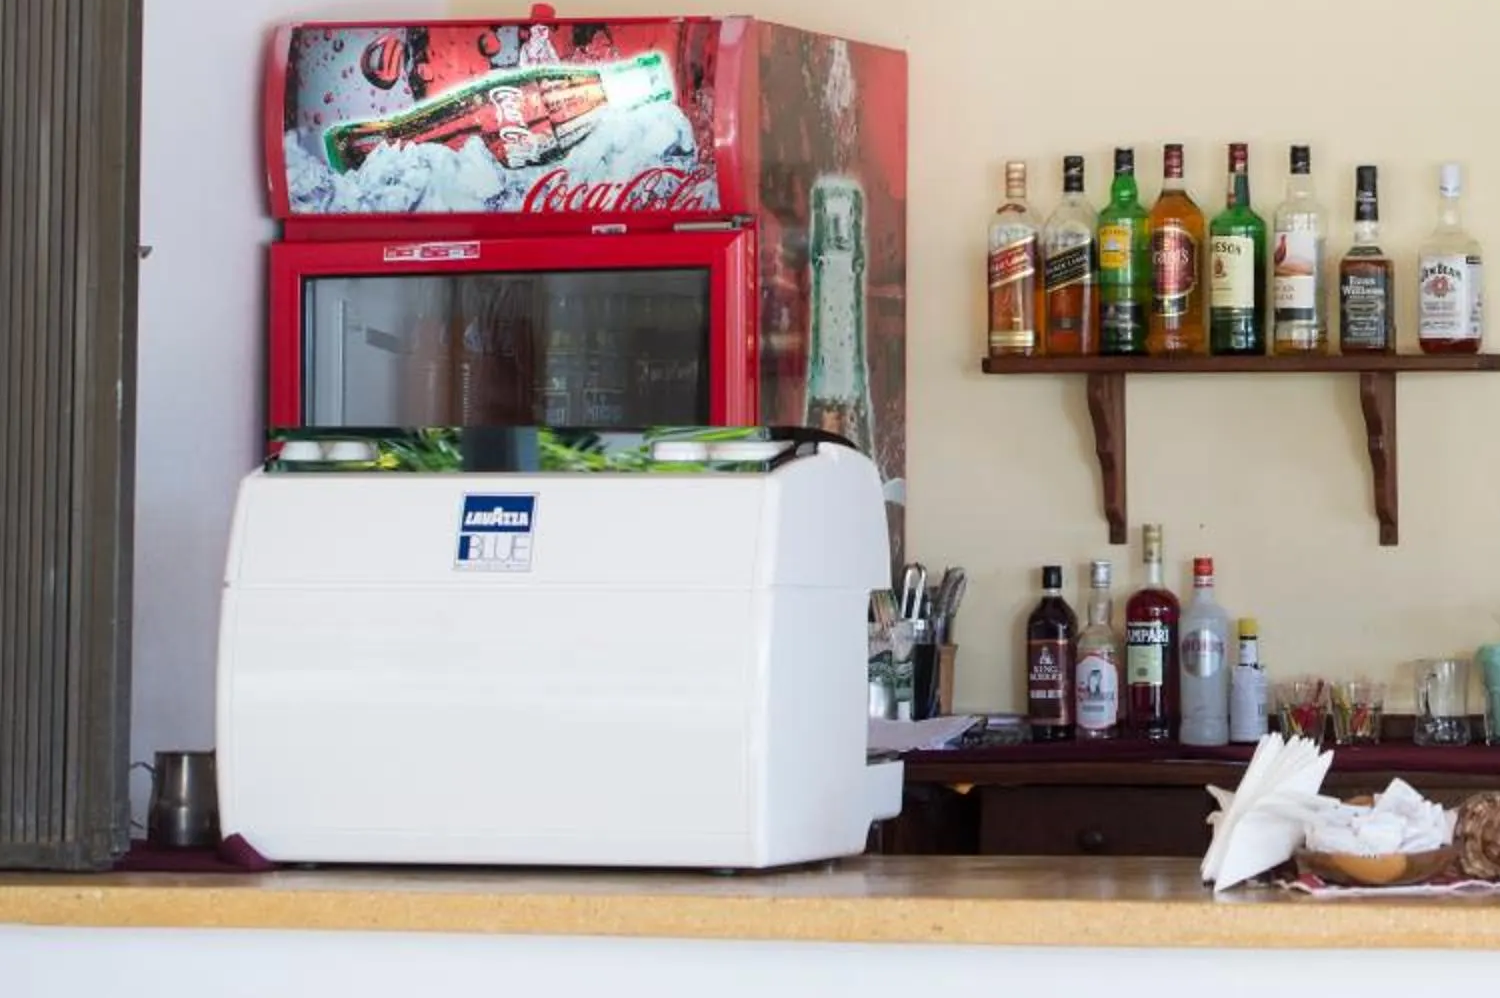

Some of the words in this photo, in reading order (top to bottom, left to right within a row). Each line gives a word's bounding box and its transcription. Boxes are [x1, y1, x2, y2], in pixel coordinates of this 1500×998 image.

[523, 168, 712, 213] Coca-Cola
[464, 506, 529, 526] LAVAZZA
[459, 534, 529, 561] BLUE
[1126, 626, 1169, 643] AMPARI
